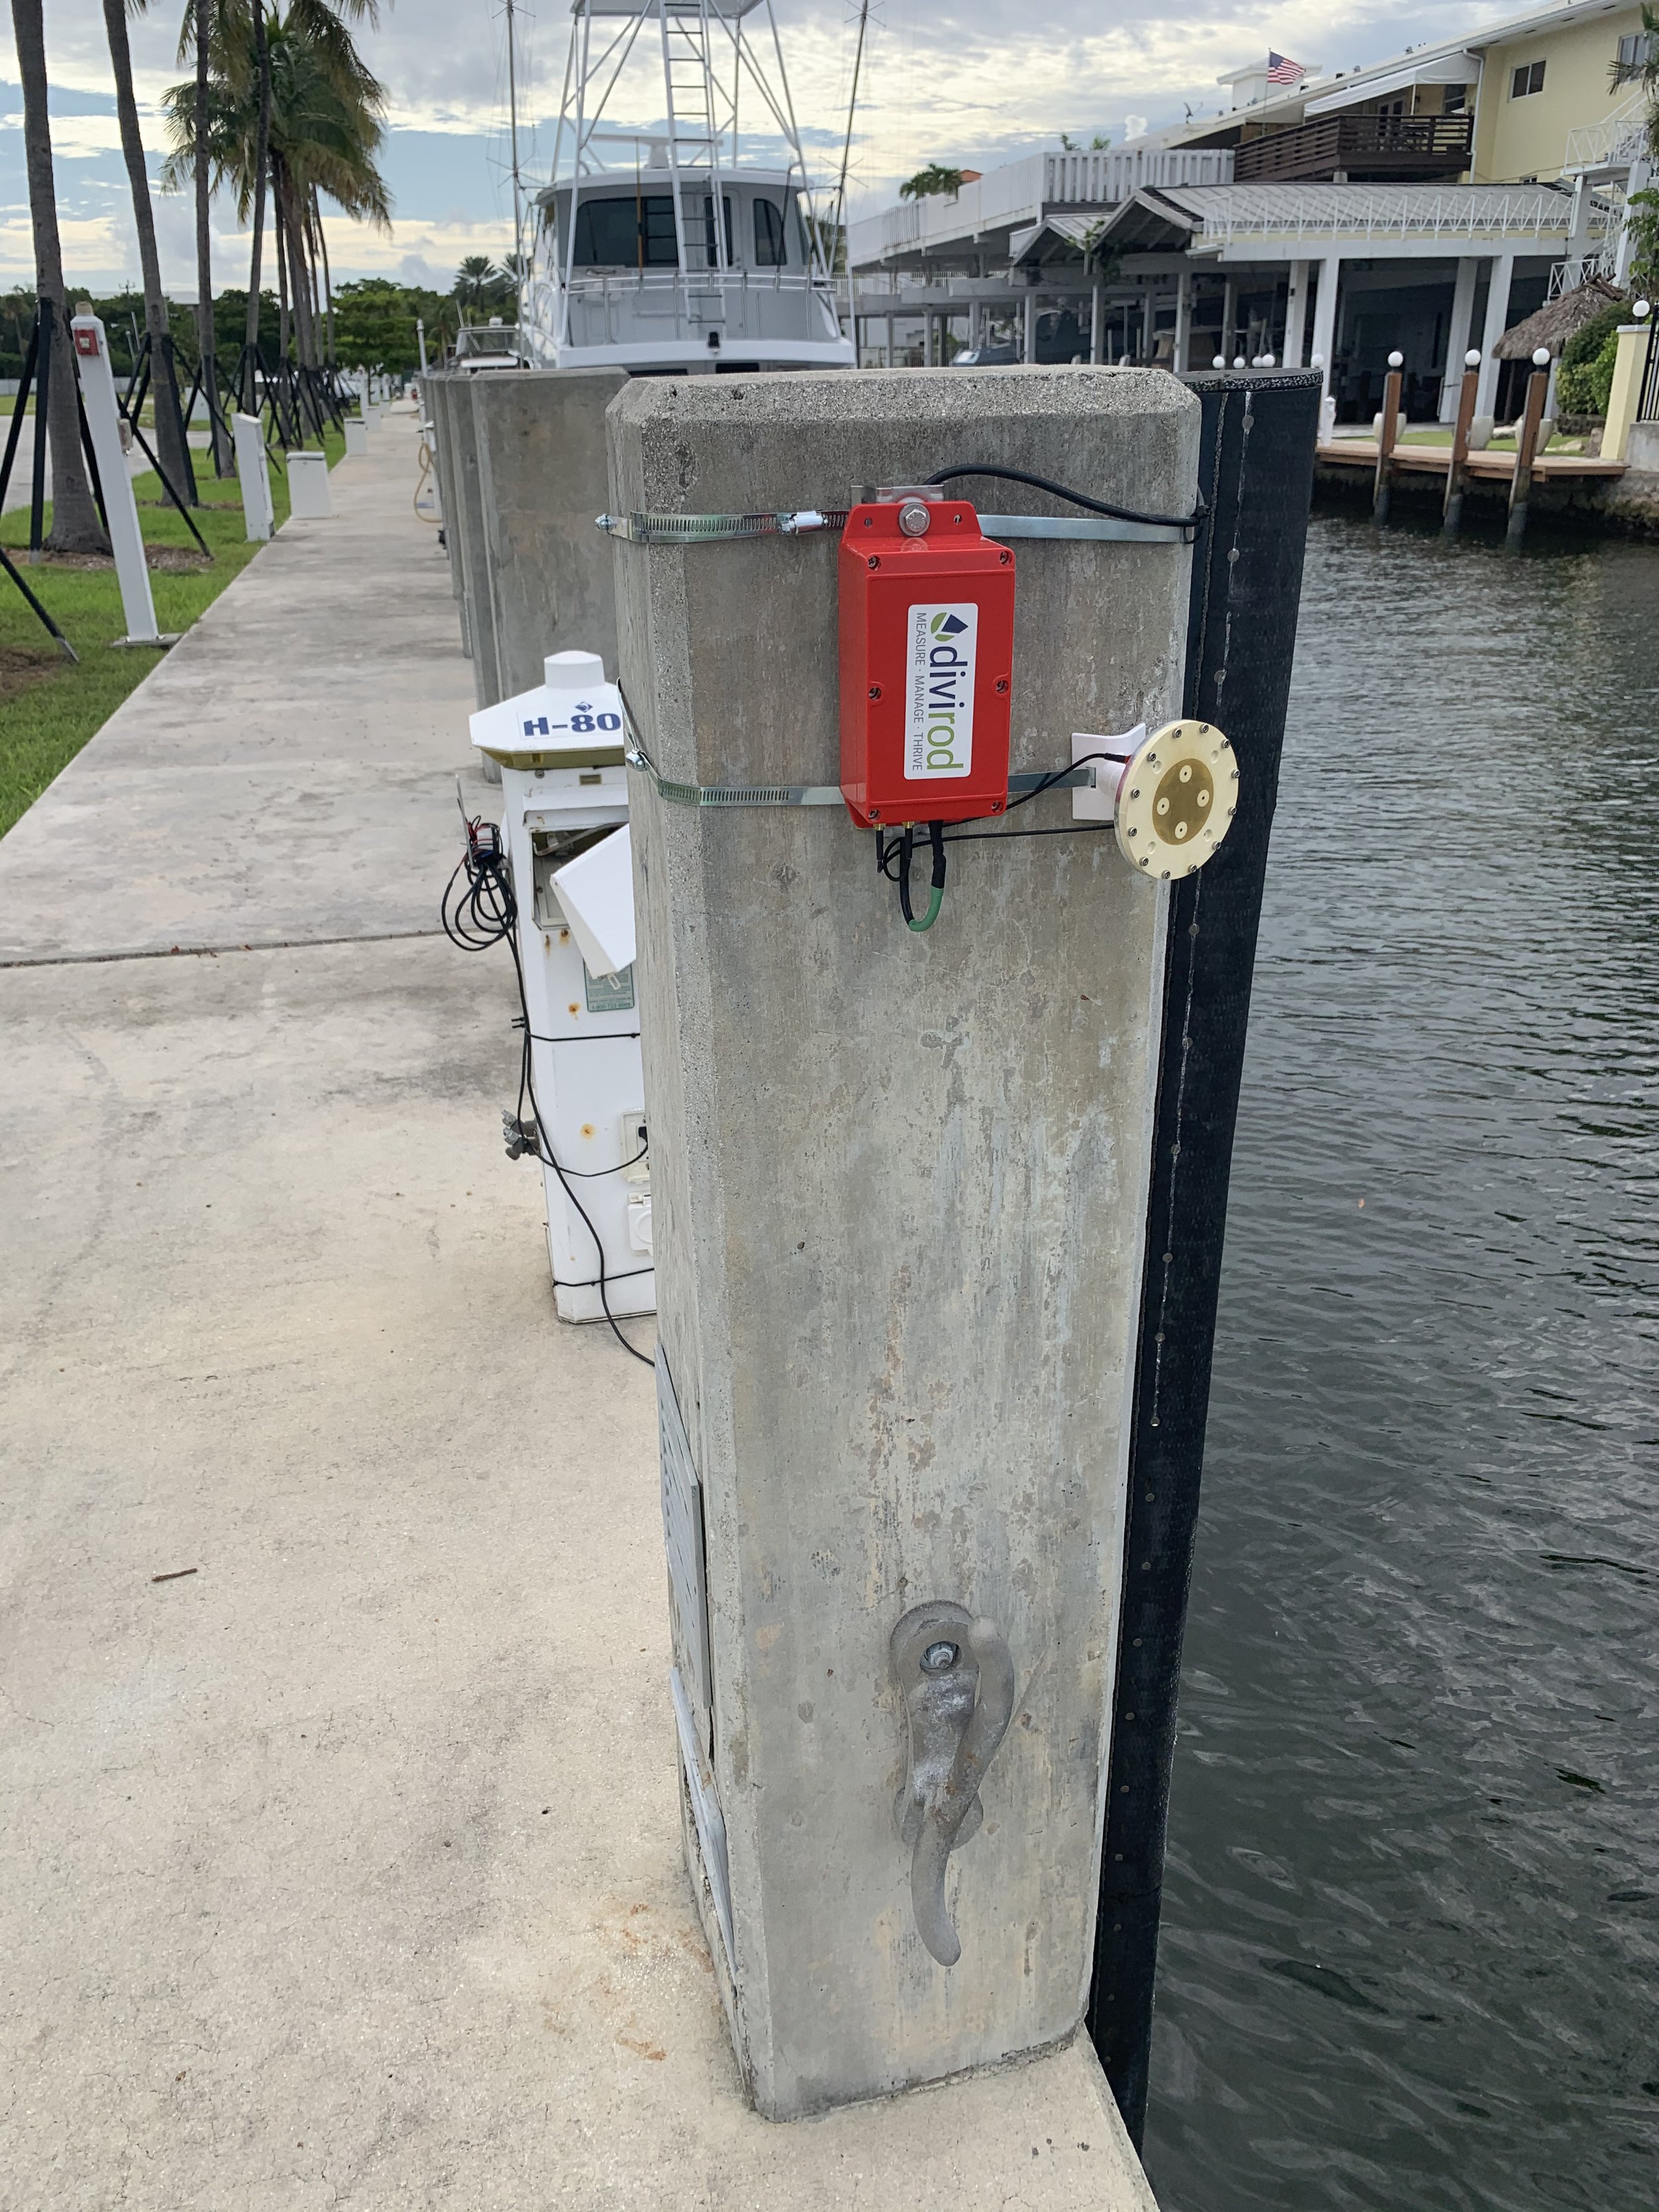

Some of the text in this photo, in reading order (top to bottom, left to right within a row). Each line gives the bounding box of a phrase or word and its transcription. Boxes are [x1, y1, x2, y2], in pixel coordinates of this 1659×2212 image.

[524, 713, 621, 736] H-80
[912, 612, 927, 771] MEASURE MANAGE THRIVE
[926, 646, 968, 770] divirod
